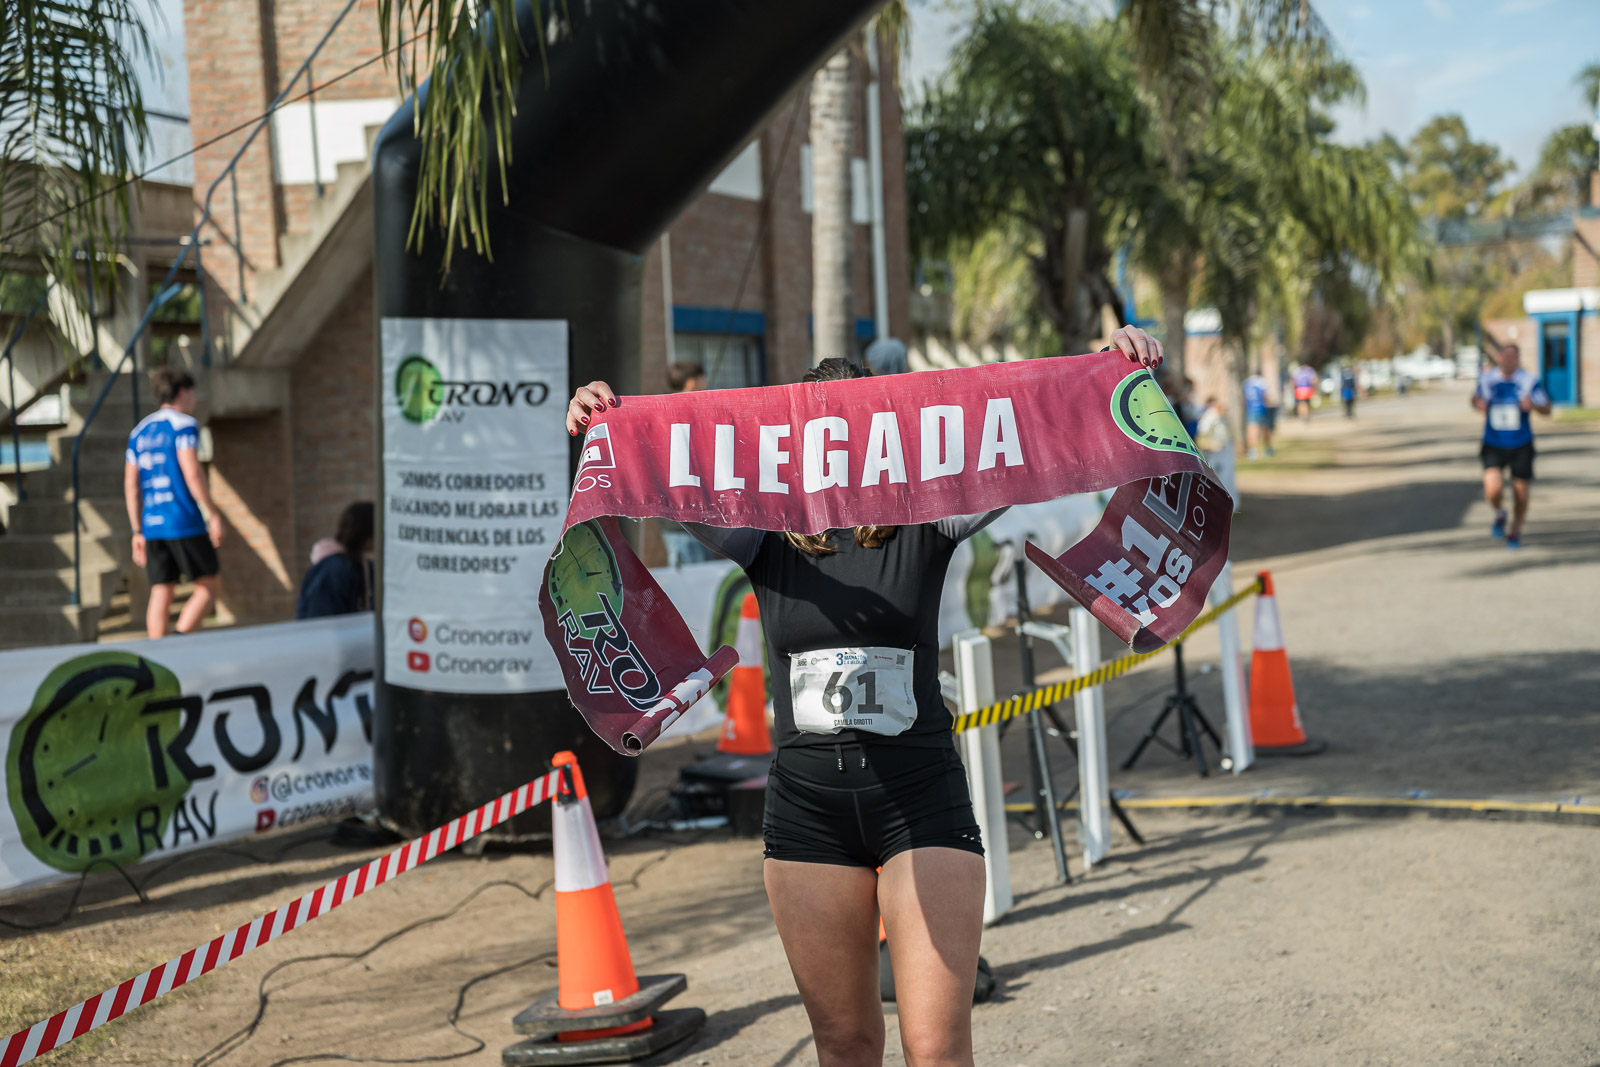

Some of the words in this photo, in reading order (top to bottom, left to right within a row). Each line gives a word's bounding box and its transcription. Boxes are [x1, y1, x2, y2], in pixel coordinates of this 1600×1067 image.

[668, 397, 1024, 495] LLEGADA
[445, 473, 546, 491] CORREDORES
[454, 501, 528, 519] MEJORAR
[531, 502, 559, 518] LAS
[398, 523, 489, 546] EXPERIENCIAS
[493, 529, 512, 546] DE
[517, 527, 546, 545] LOS
[435, 622, 532, 646] Cronorav
[557, 608, 614, 694] RAV
[435, 653, 532, 674] Cronorav
[822, 671, 884, 715] 61
[834, 718, 853, 726] CAMILA
[135, 789, 219, 855] RAV
